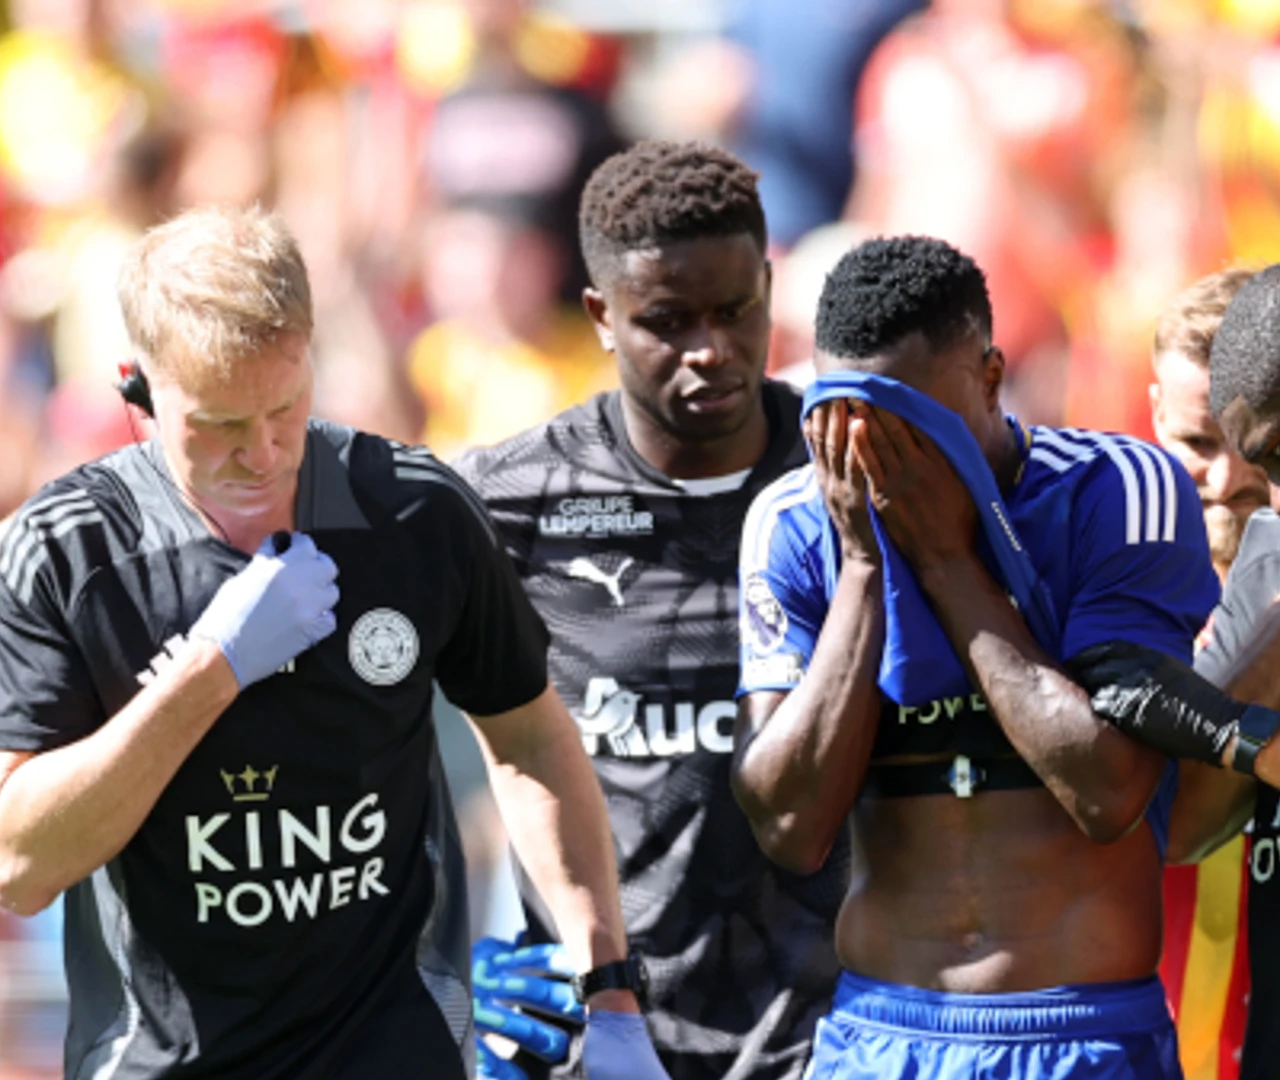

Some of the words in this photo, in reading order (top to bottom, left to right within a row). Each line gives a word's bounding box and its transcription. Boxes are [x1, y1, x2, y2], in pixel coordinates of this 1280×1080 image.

[539, 512, 654, 535] LEMPEREUR
[185, 793, 387, 872] KING
[194, 857, 391, 926] POWER
